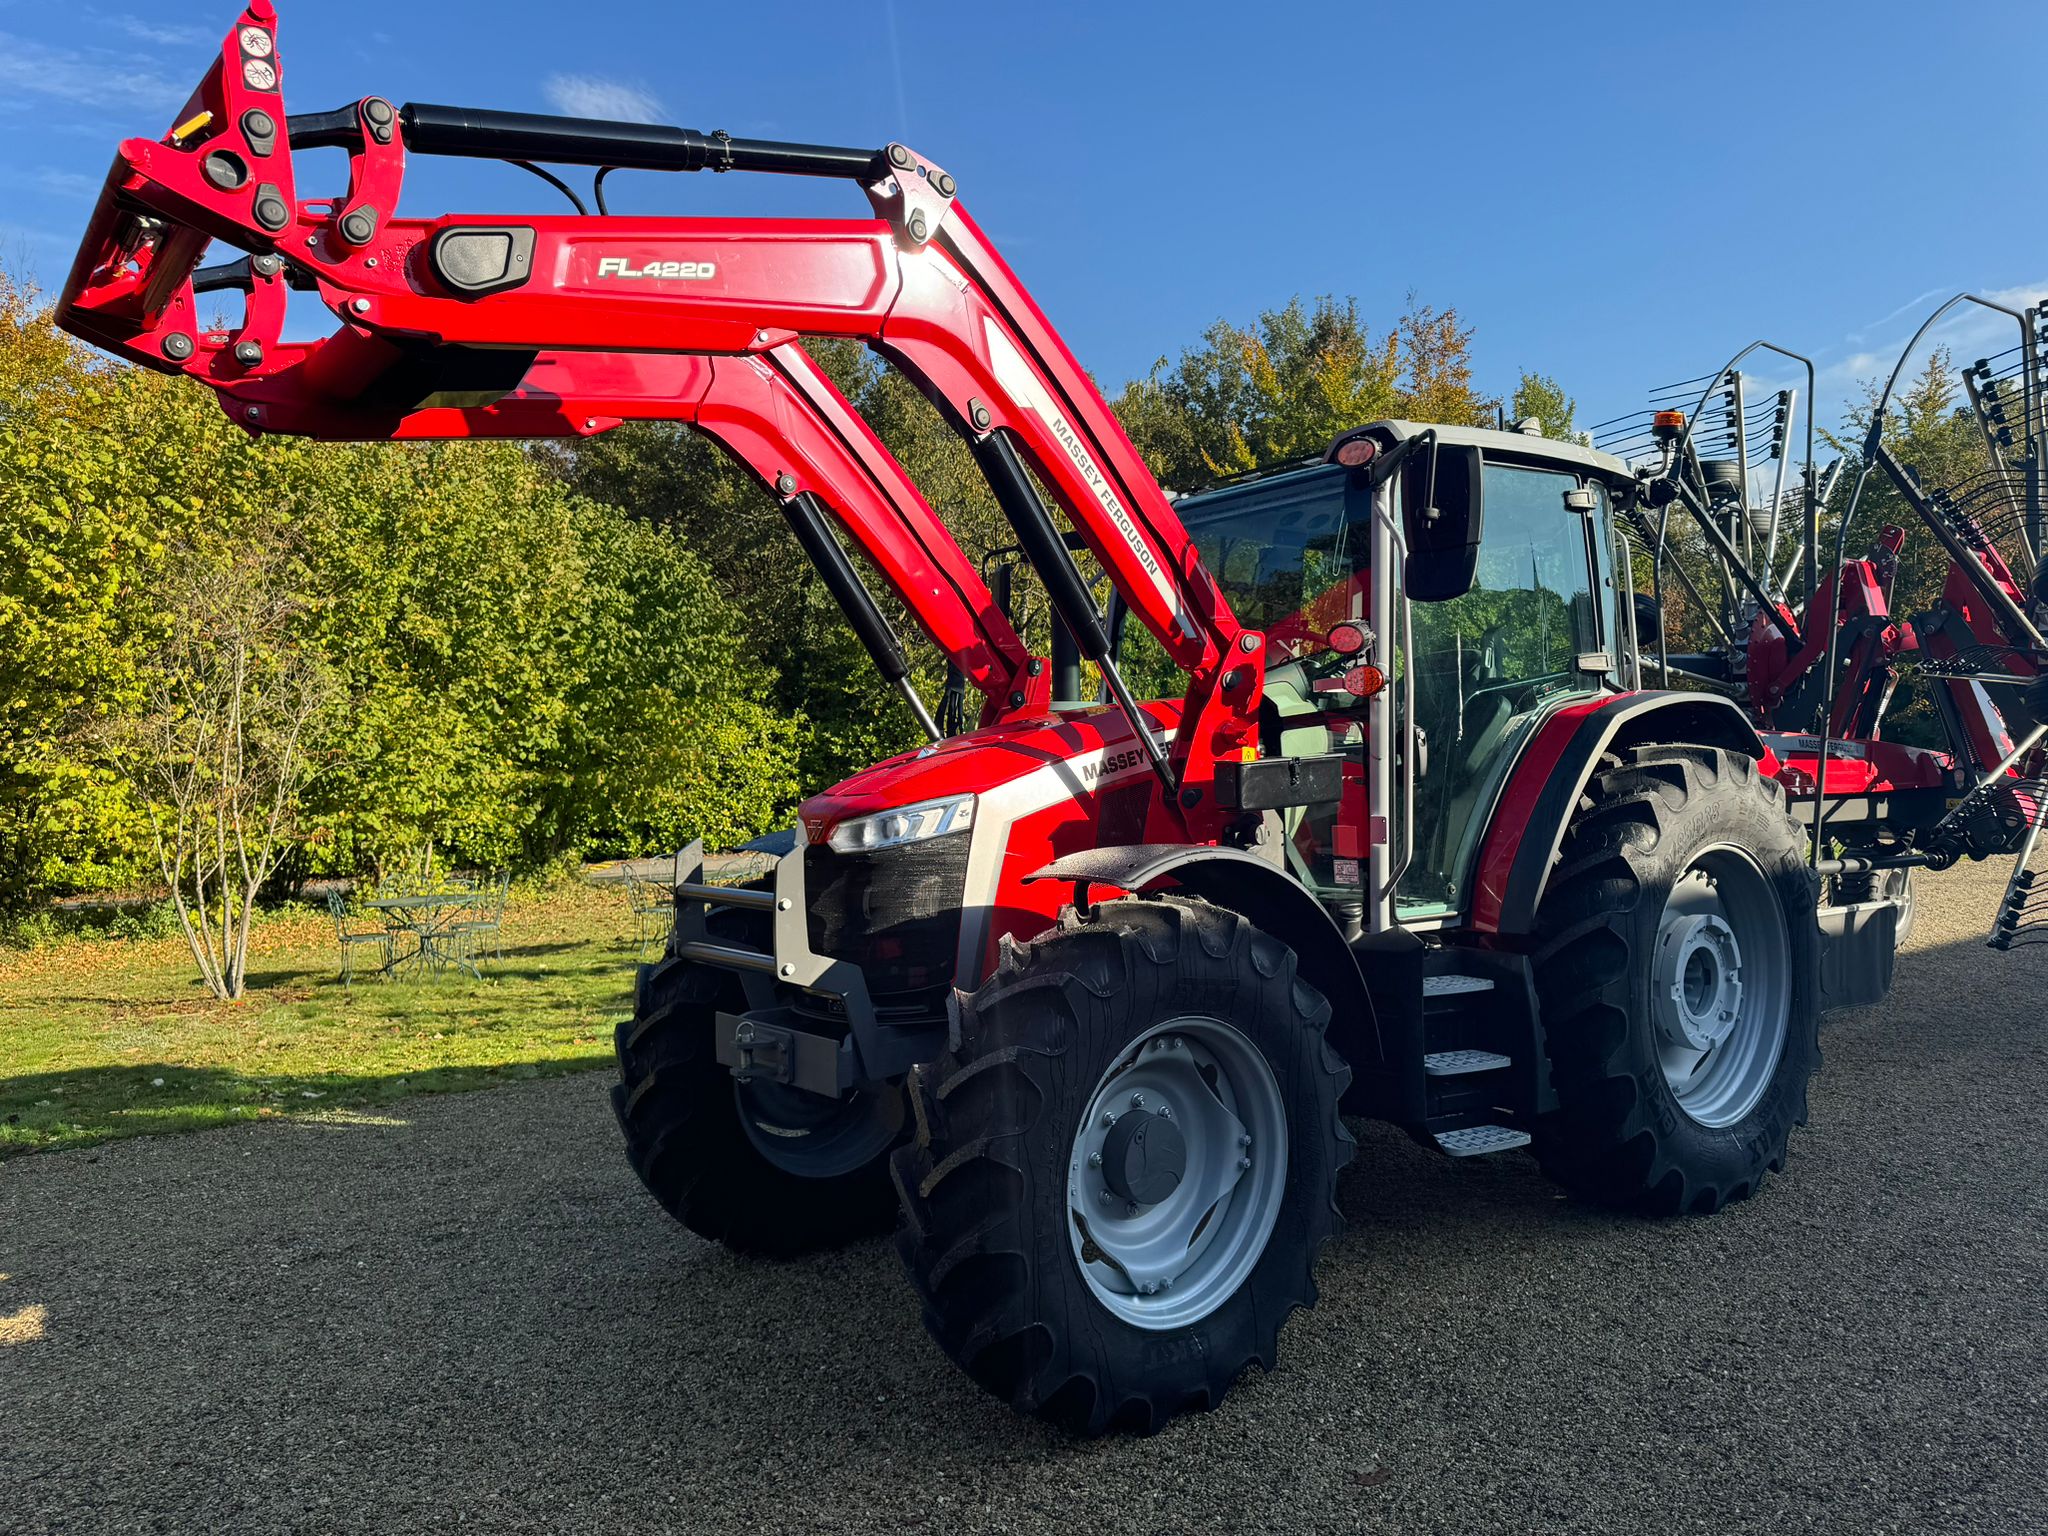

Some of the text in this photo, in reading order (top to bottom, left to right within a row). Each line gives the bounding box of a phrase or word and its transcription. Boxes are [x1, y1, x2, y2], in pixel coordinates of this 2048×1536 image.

[597, 257, 716, 279] FL.4220
[1052, 418, 1158, 575] MASSEY FERGUSON
[1799, 738, 1821, 751] MASSE
[1082, 748, 1145, 781] MASSEY
